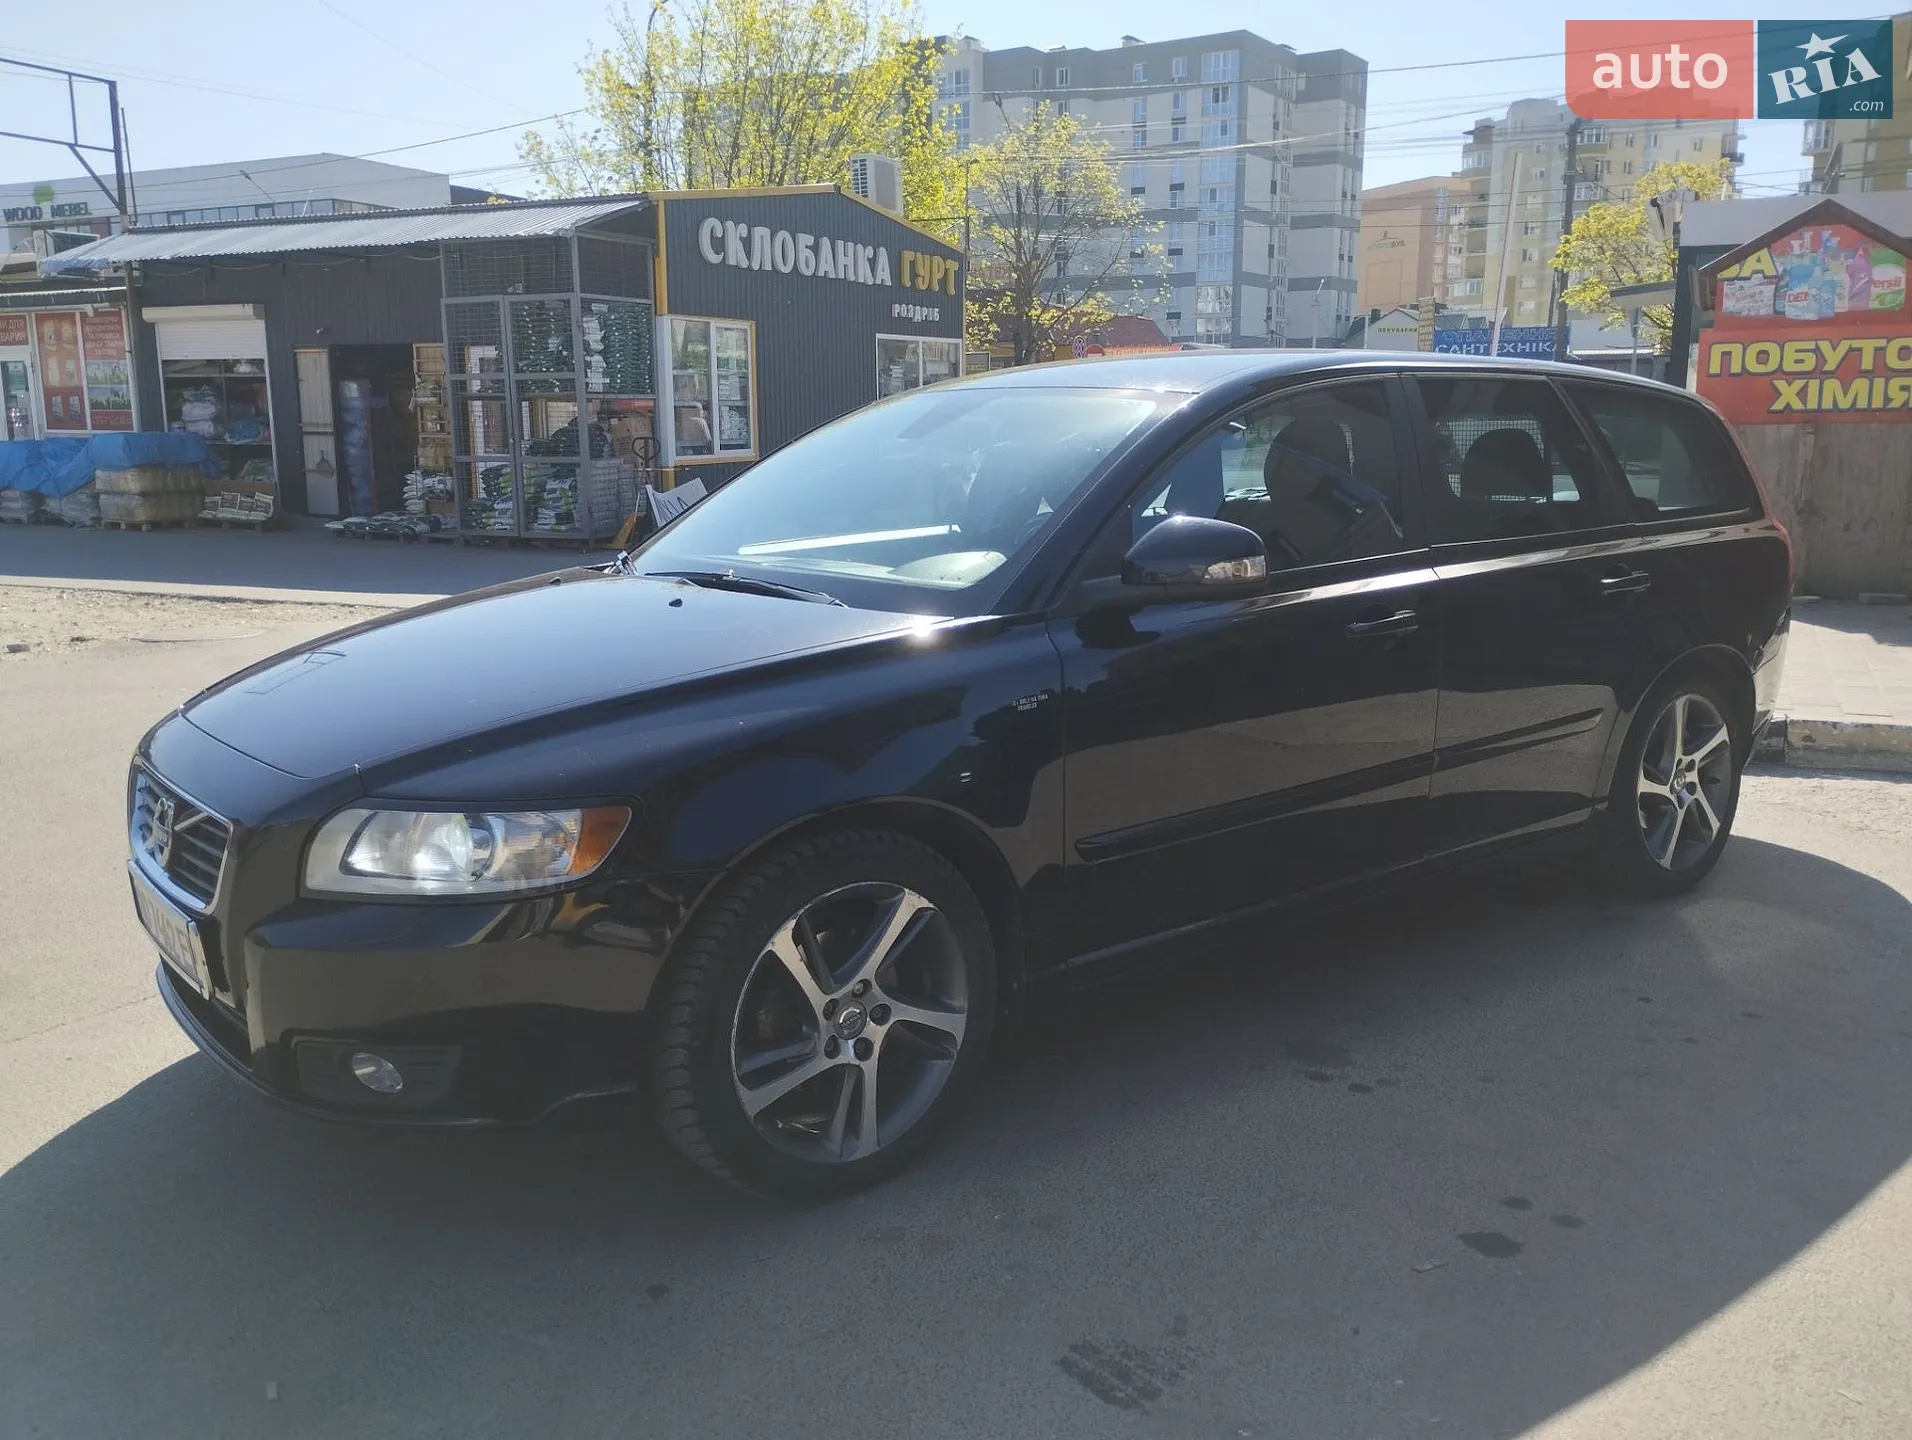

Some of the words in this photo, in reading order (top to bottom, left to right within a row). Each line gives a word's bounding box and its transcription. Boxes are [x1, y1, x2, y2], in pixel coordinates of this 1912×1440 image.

[3, 205, 42, 222] WOOD
[50, 202, 93, 218] MEBEL
[698, 217, 892, 287] СКЛОБАНКА
[901, 249, 960, 296] ГУРТ
[891, 303, 940, 323] РОЗДРІБ
[1708, 336, 1912, 376] ПОБУТО
[1769, 377, 1912, 412] ХІМІЯ
